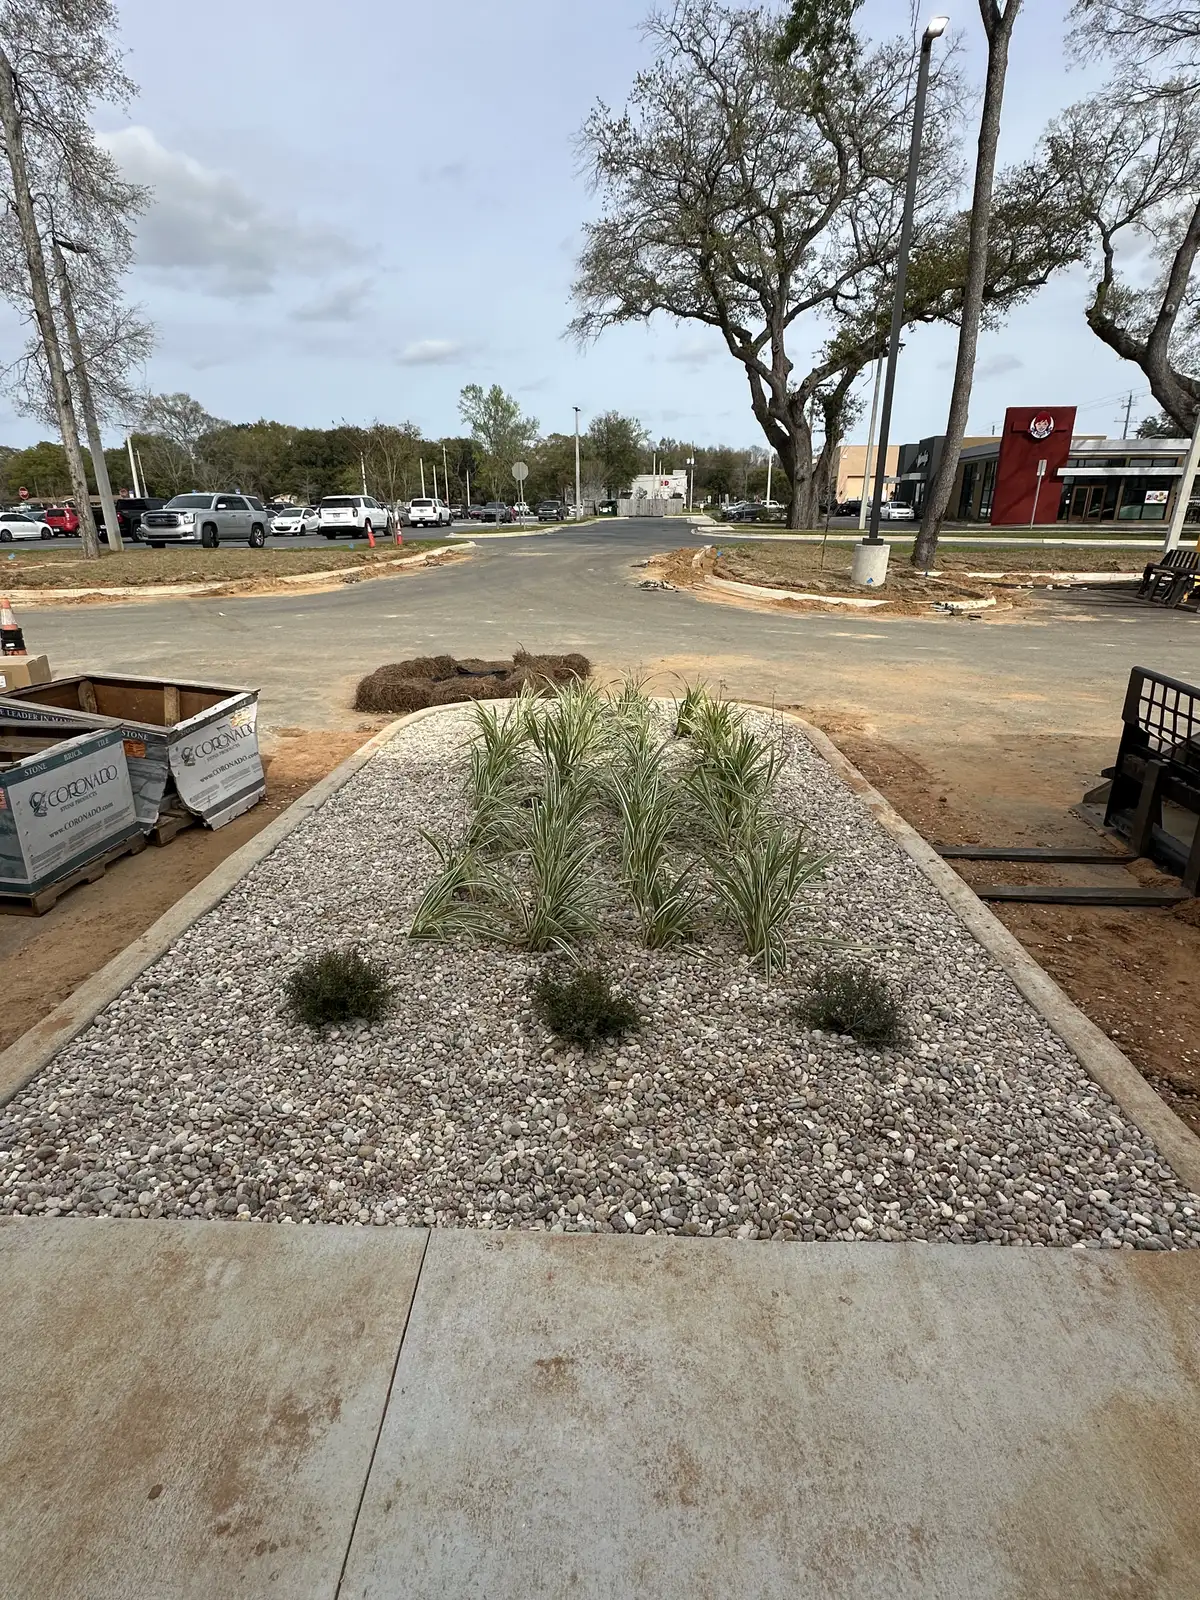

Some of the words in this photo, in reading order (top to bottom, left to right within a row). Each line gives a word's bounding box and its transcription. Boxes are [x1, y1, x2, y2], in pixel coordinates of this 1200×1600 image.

[7, 709, 39, 721] LEADER
[40, 714, 50, 722] IN
[121, 730, 149, 741] STONE
[195, 721, 257, 758] CORONADO
[24, 764, 48, 777] STONE
[63, 748, 83, 761] BRICK
[97, 737, 110, 748] TILE
[199, 751, 259, 783] www.CORONADO.com
[48, 764, 118, 807] CORONADO
[60, 800, 76, 813] STONE
[75, 791, 98, 805] PRODUCTS
[48, 801, 114, 839] www.CORONADO.com
